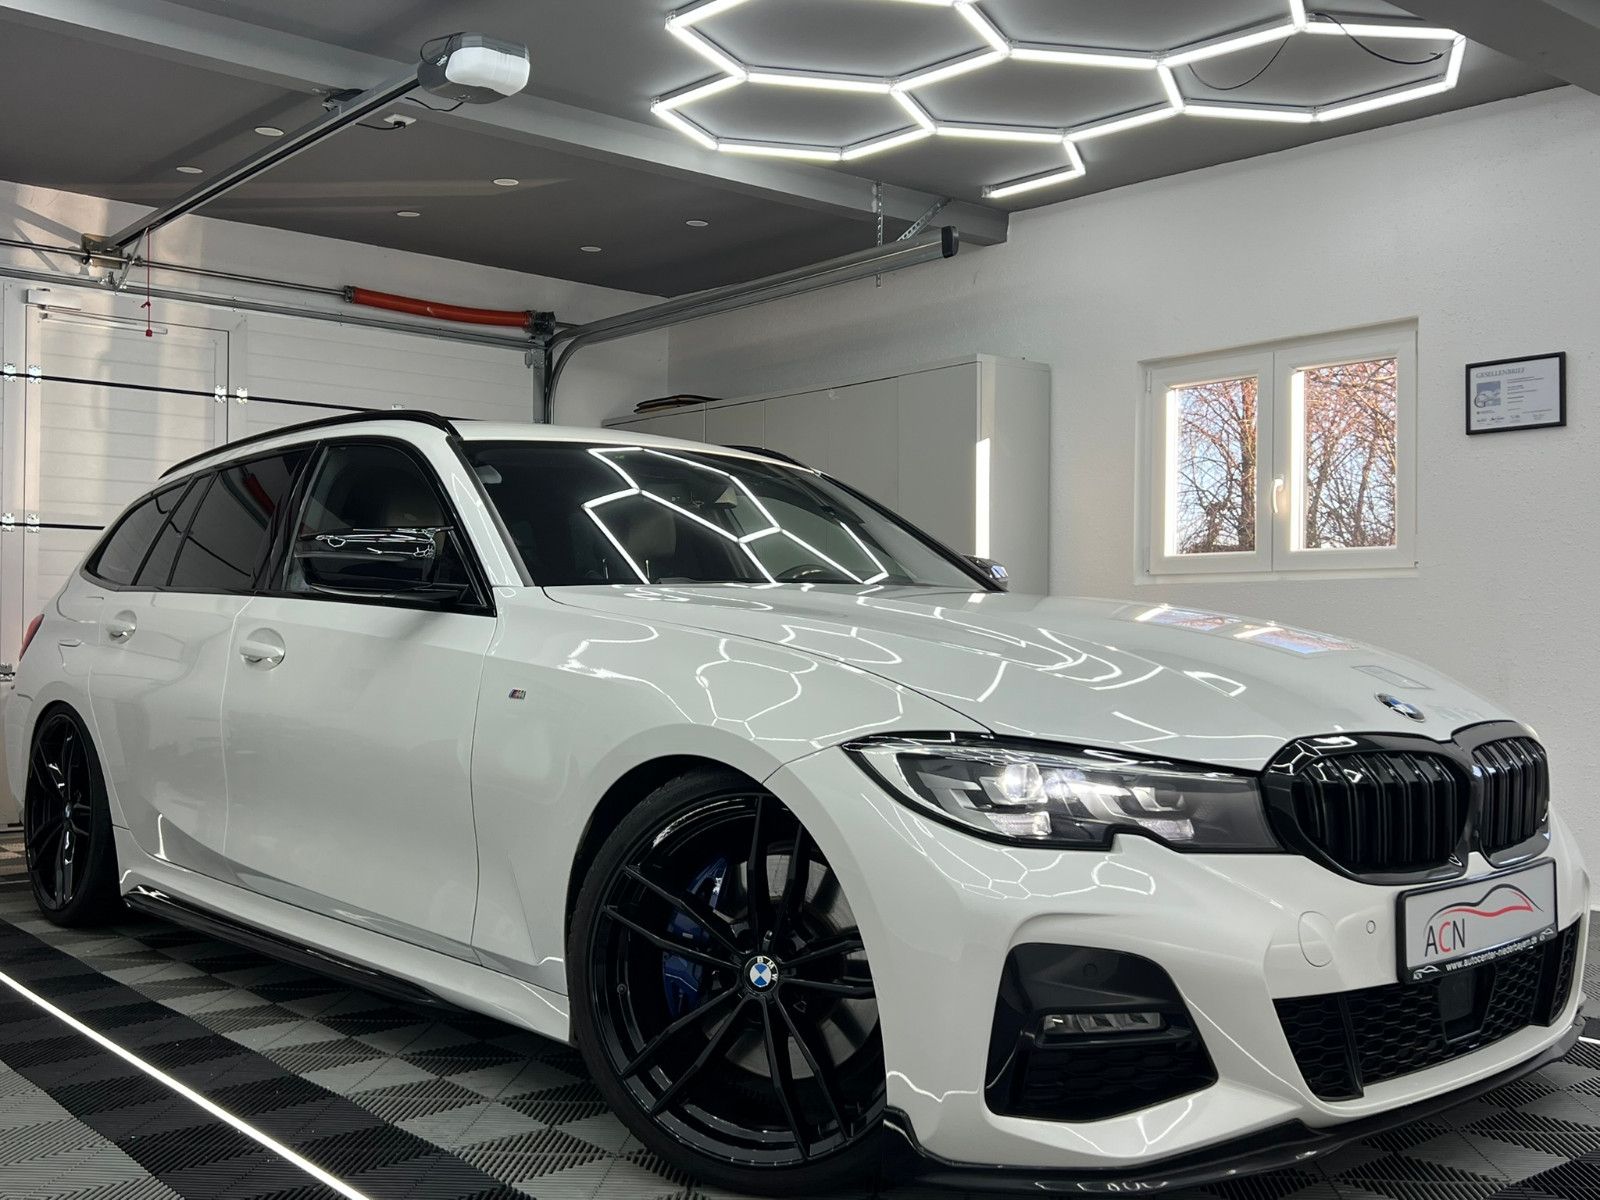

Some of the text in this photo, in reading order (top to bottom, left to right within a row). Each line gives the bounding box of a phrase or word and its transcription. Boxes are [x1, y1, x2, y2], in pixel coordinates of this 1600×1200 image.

[1476, 367, 1525, 378] GESELLENBRIEF
[1424, 918, 1466, 958] ACN
[756, 955, 779, 982] BMW
[1445, 937, 1538, 971] www.autocenter-niederbayern.de
